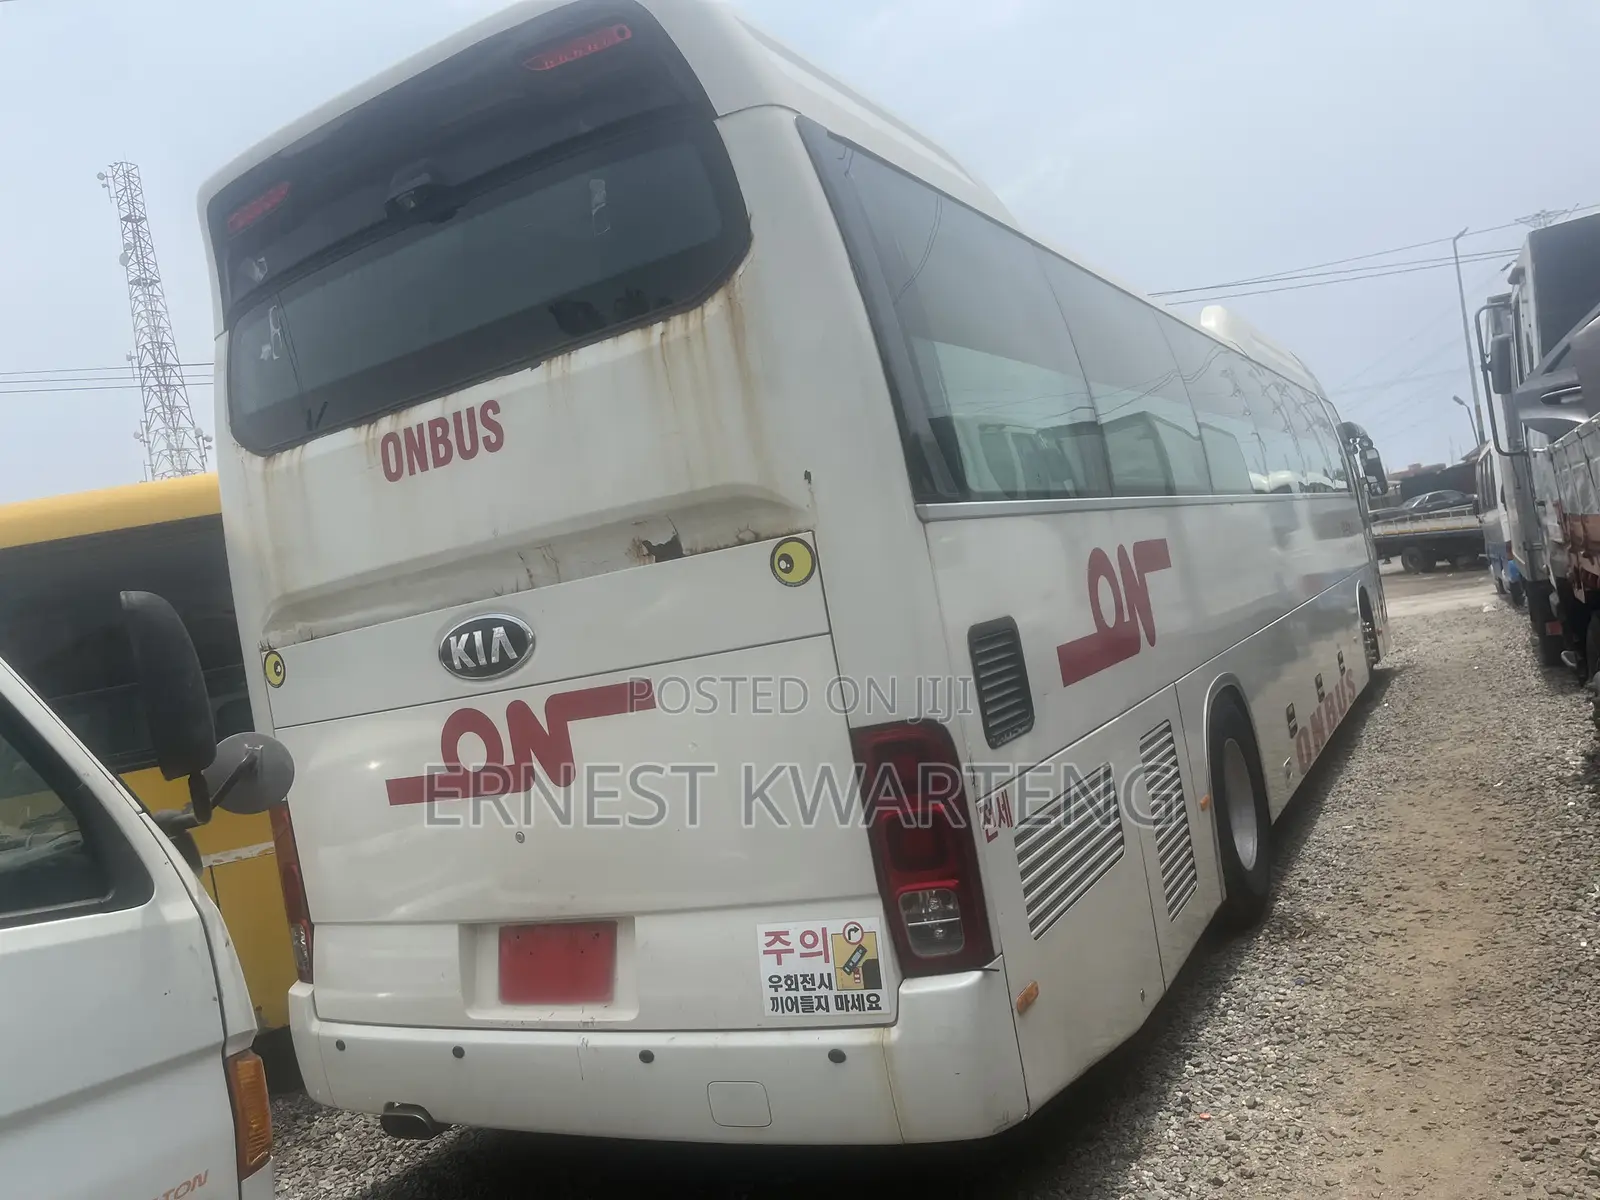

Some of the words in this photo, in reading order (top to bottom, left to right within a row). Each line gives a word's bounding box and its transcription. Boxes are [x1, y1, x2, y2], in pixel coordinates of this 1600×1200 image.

[381, 399, 504, 482] ONBUS
[1057, 538, 1172, 688] ON
[449, 626, 518, 670] KIA
[1296, 668, 1356, 776] ONBUS
[979, 788, 1014, 844] 전세
[763, 927, 831, 966] 주의
[768, 972, 834, 993] 우회전시
[770, 995, 831, 1014] 끼어들지
[834, 993, 882, 1012] 마세요
[152, 1168, 209, 1200] TON
